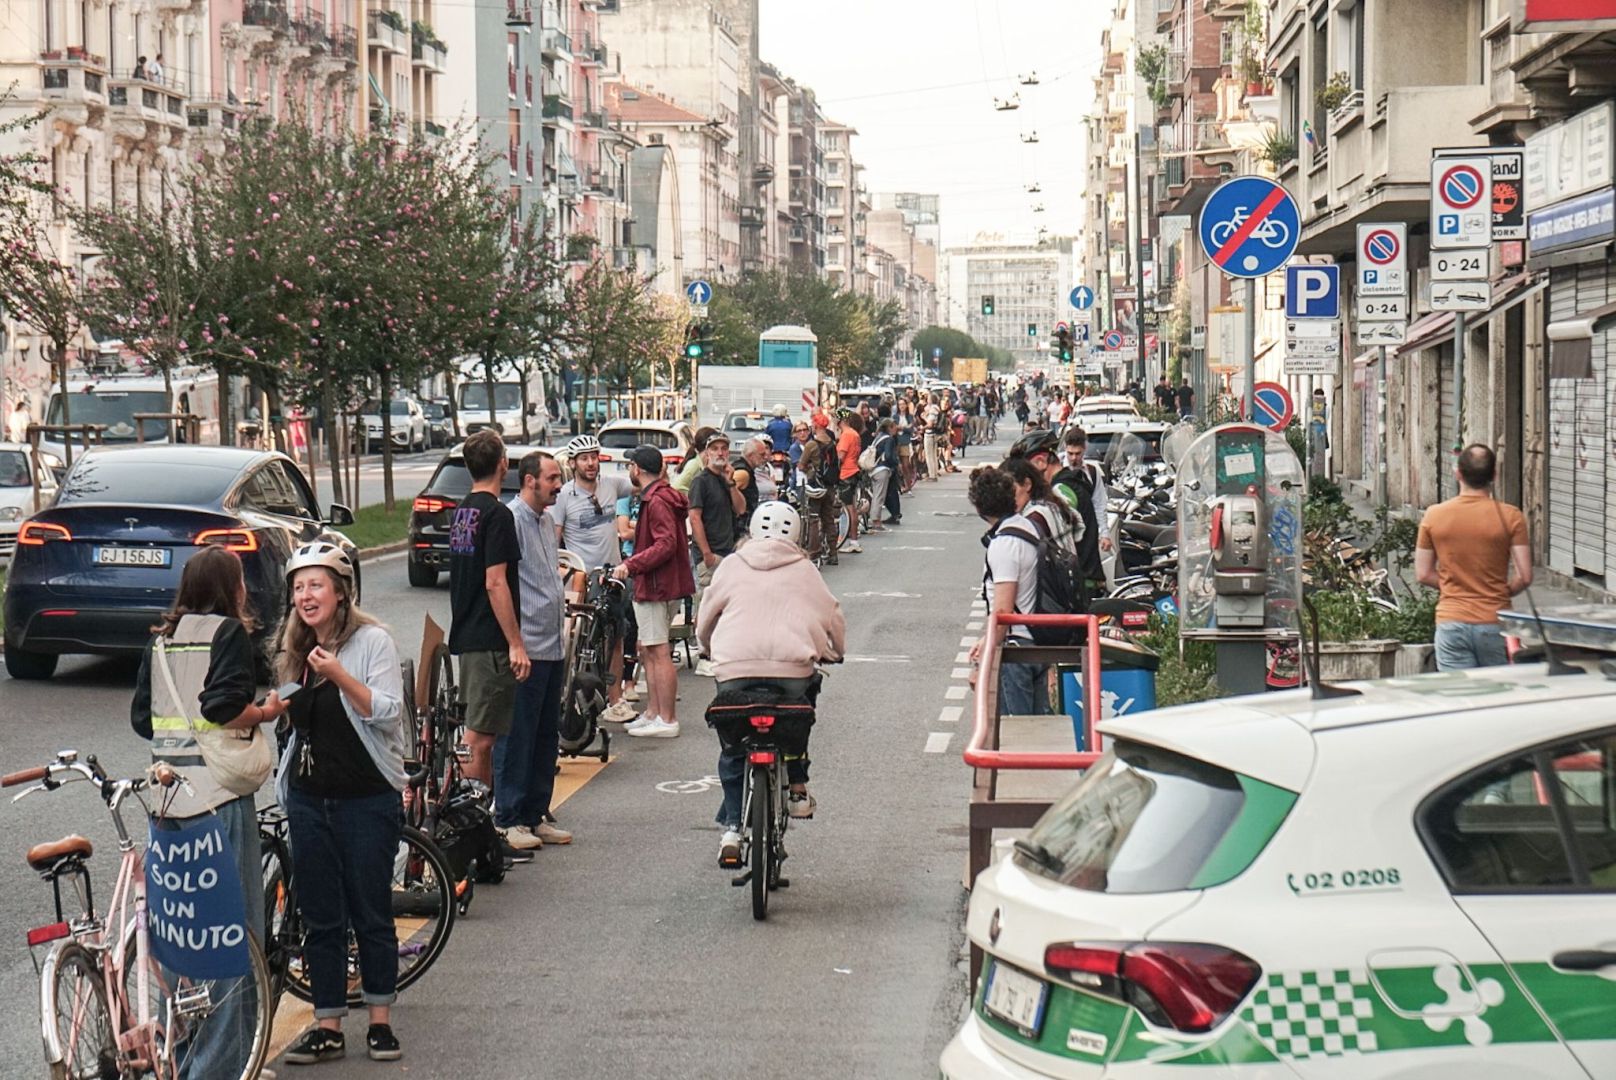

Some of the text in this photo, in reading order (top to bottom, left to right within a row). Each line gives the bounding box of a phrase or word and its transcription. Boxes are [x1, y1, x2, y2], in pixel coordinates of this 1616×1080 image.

[1493, 158, 1518, 175] and
[1443, 217, 1456, 233] P
[1366, 271, 1376, 282] P
[1297, 270, 1331, 314] P
[149, 828, 223, 863] AMMI
[151, 863, 218, 893] SOLO
[1305, 868, 1401, 889] 02 0208
[163, 898, 195, 919] UN
[149, 908, 244, 951] MINUTO
